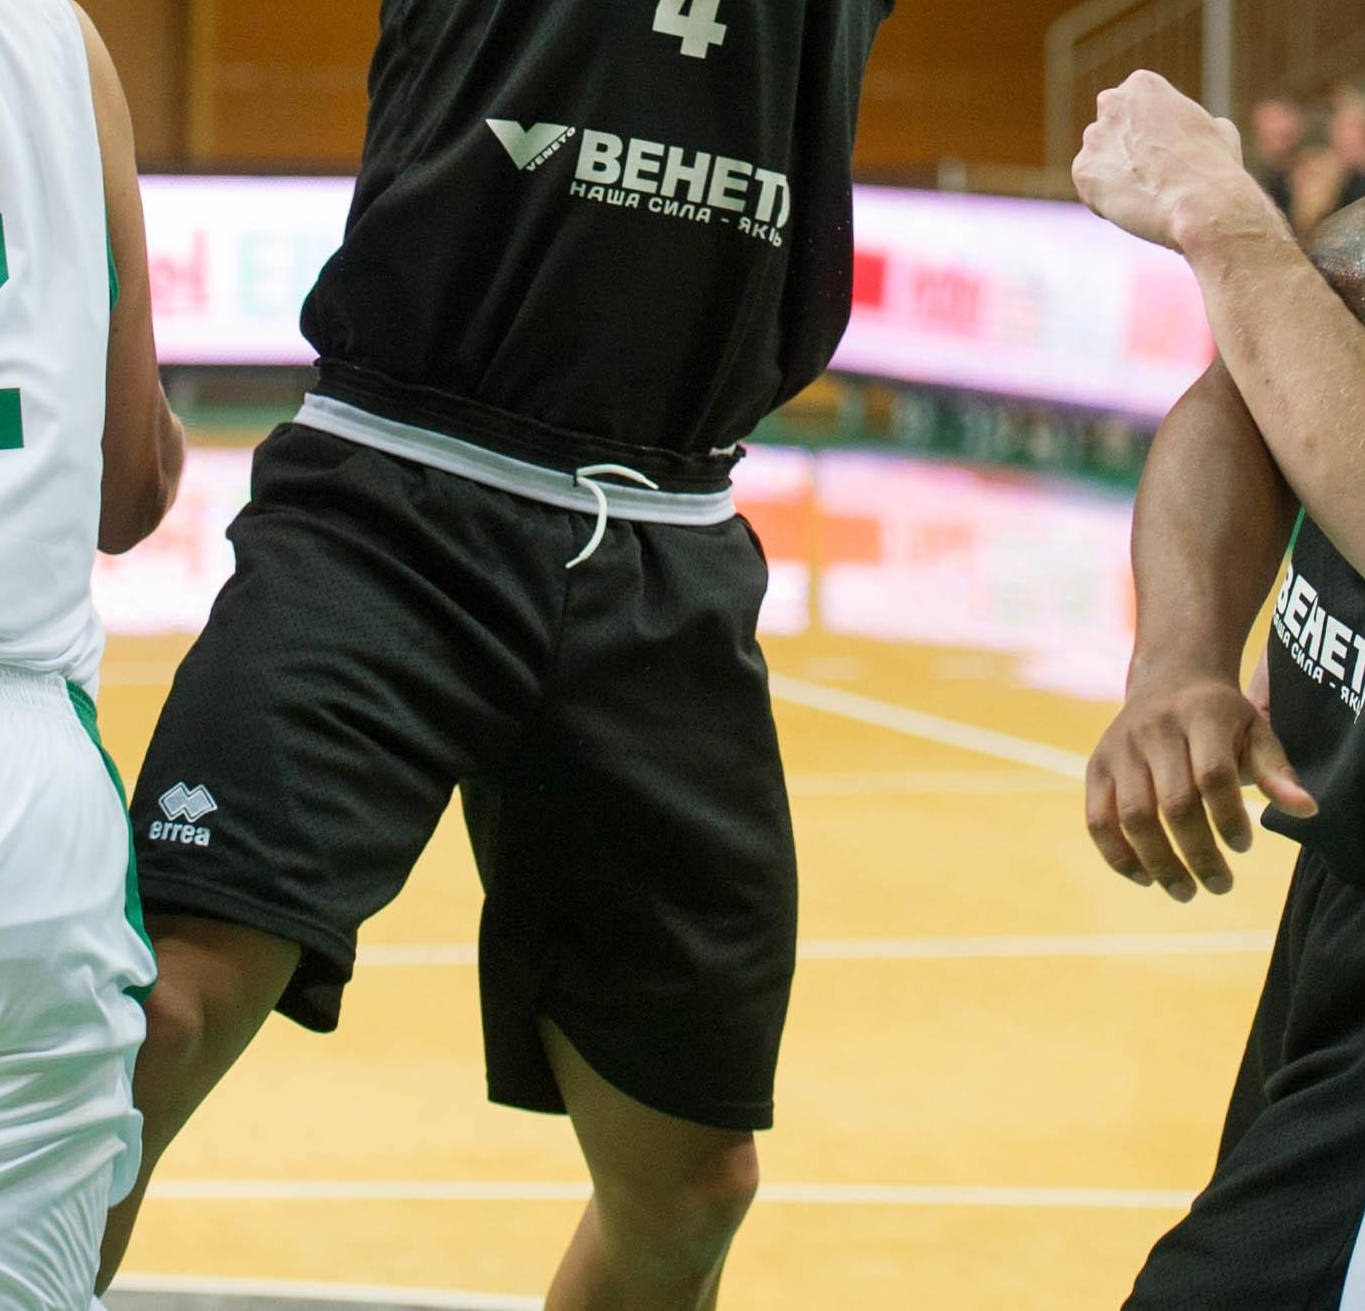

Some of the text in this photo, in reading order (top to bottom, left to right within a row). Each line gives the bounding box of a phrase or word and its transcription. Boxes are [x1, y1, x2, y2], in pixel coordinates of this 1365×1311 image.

[570, 181, 641, 209] НАША
[648, 197, 712, 224] СИЛА
[148, 820, 212, 847] errea
